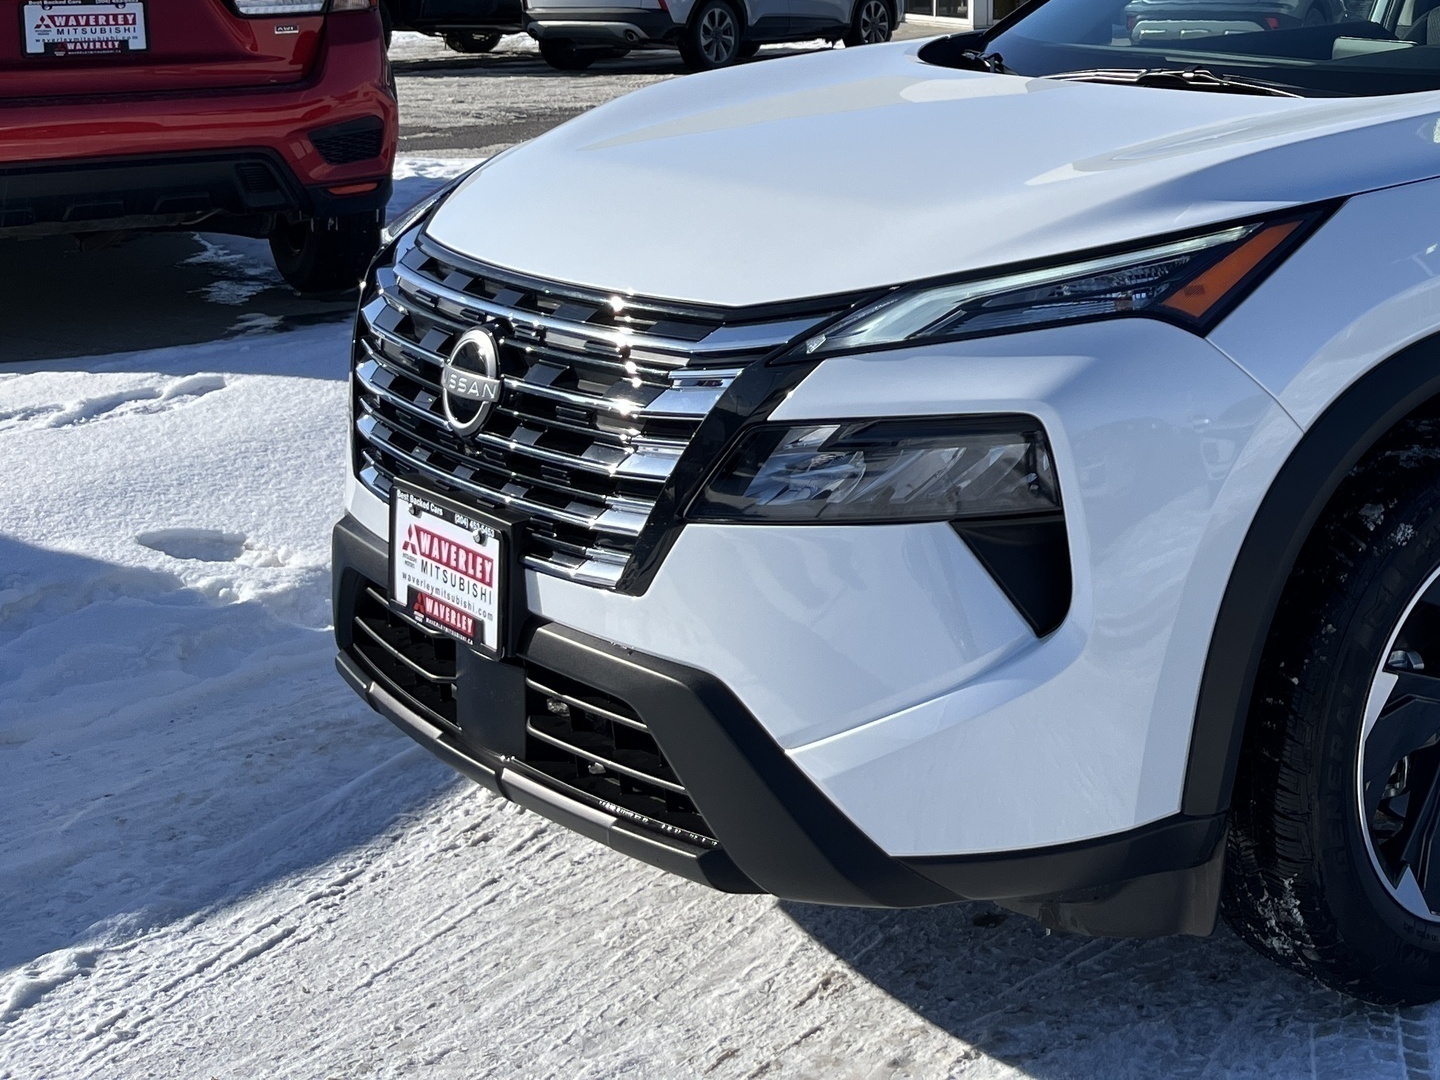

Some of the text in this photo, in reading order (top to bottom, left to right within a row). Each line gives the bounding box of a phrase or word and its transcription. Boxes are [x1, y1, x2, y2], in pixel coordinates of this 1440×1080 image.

[54, 14, 135, 27] WAVERLEY
[56, 26, 137, 36] MITSUBISHI
[66, 41, 120, 50] WAVERLEY
[409, 494, 430, 511] Backed
[430, 502, 443, 516] Cars
[419, 529, 493, 584] WAVERLEY
[401, 571, 494, 622] waverleymitsubishi.com
[420, 558, 492, 606] MITSUBISHI
[424, 596, 474, 634] WAVERLEY
